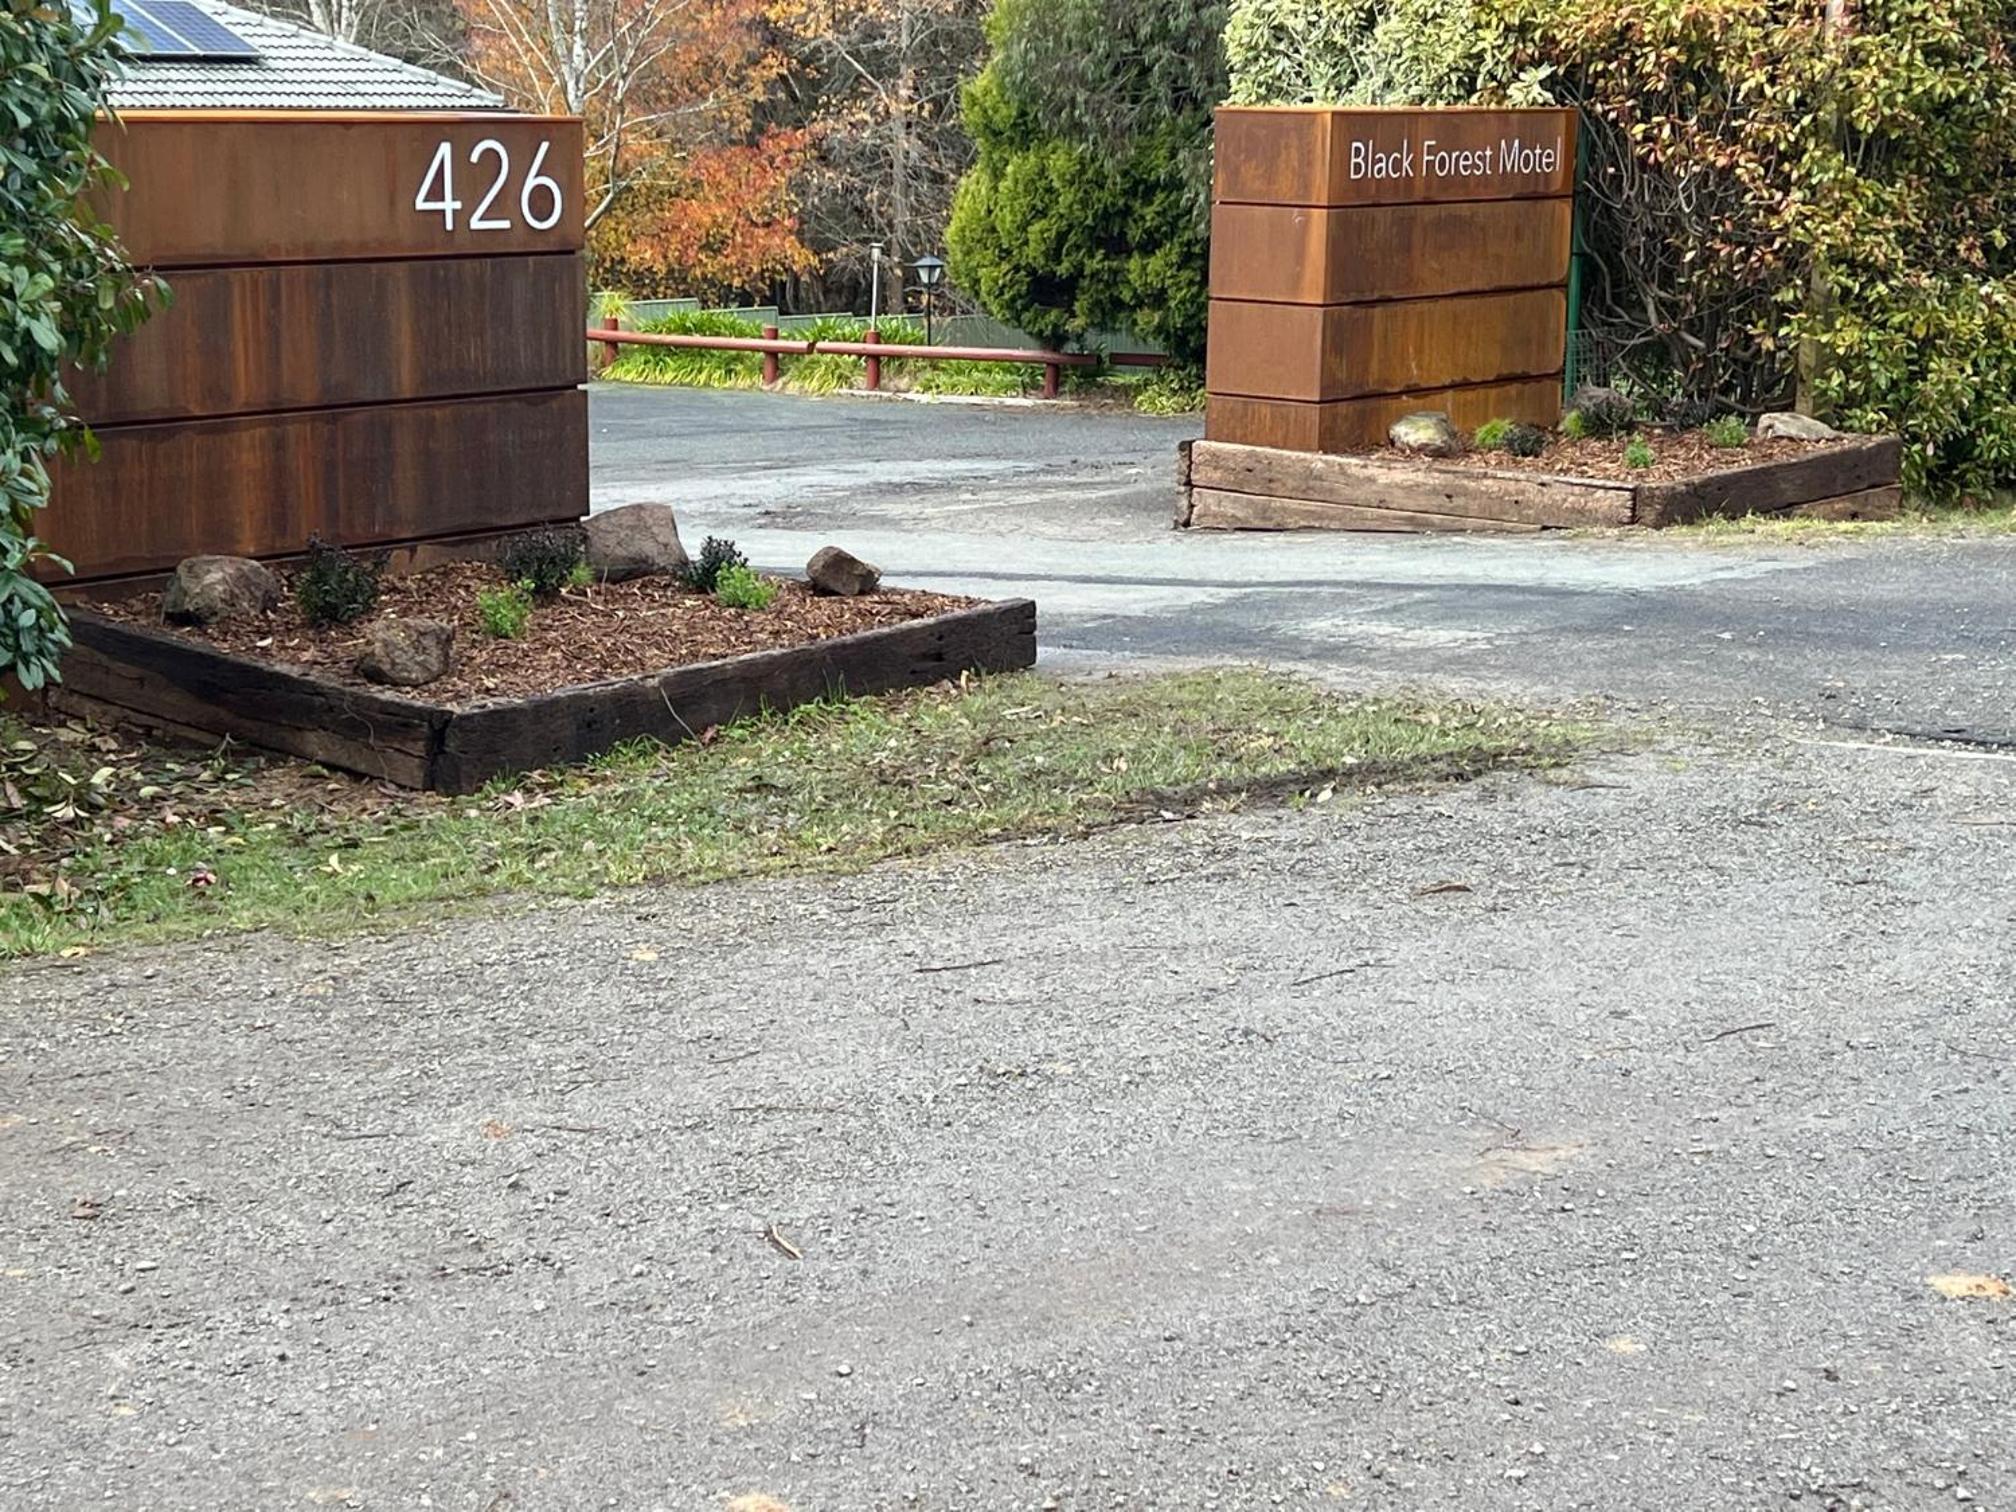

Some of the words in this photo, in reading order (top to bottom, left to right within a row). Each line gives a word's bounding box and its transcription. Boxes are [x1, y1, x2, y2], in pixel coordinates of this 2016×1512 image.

[414, 138, 563, 231] 426
[1350, 139, 1414, 179] Black
[1422, 140, 1493, 177] Forest
[1499, 136, 1562, 174] Motel
